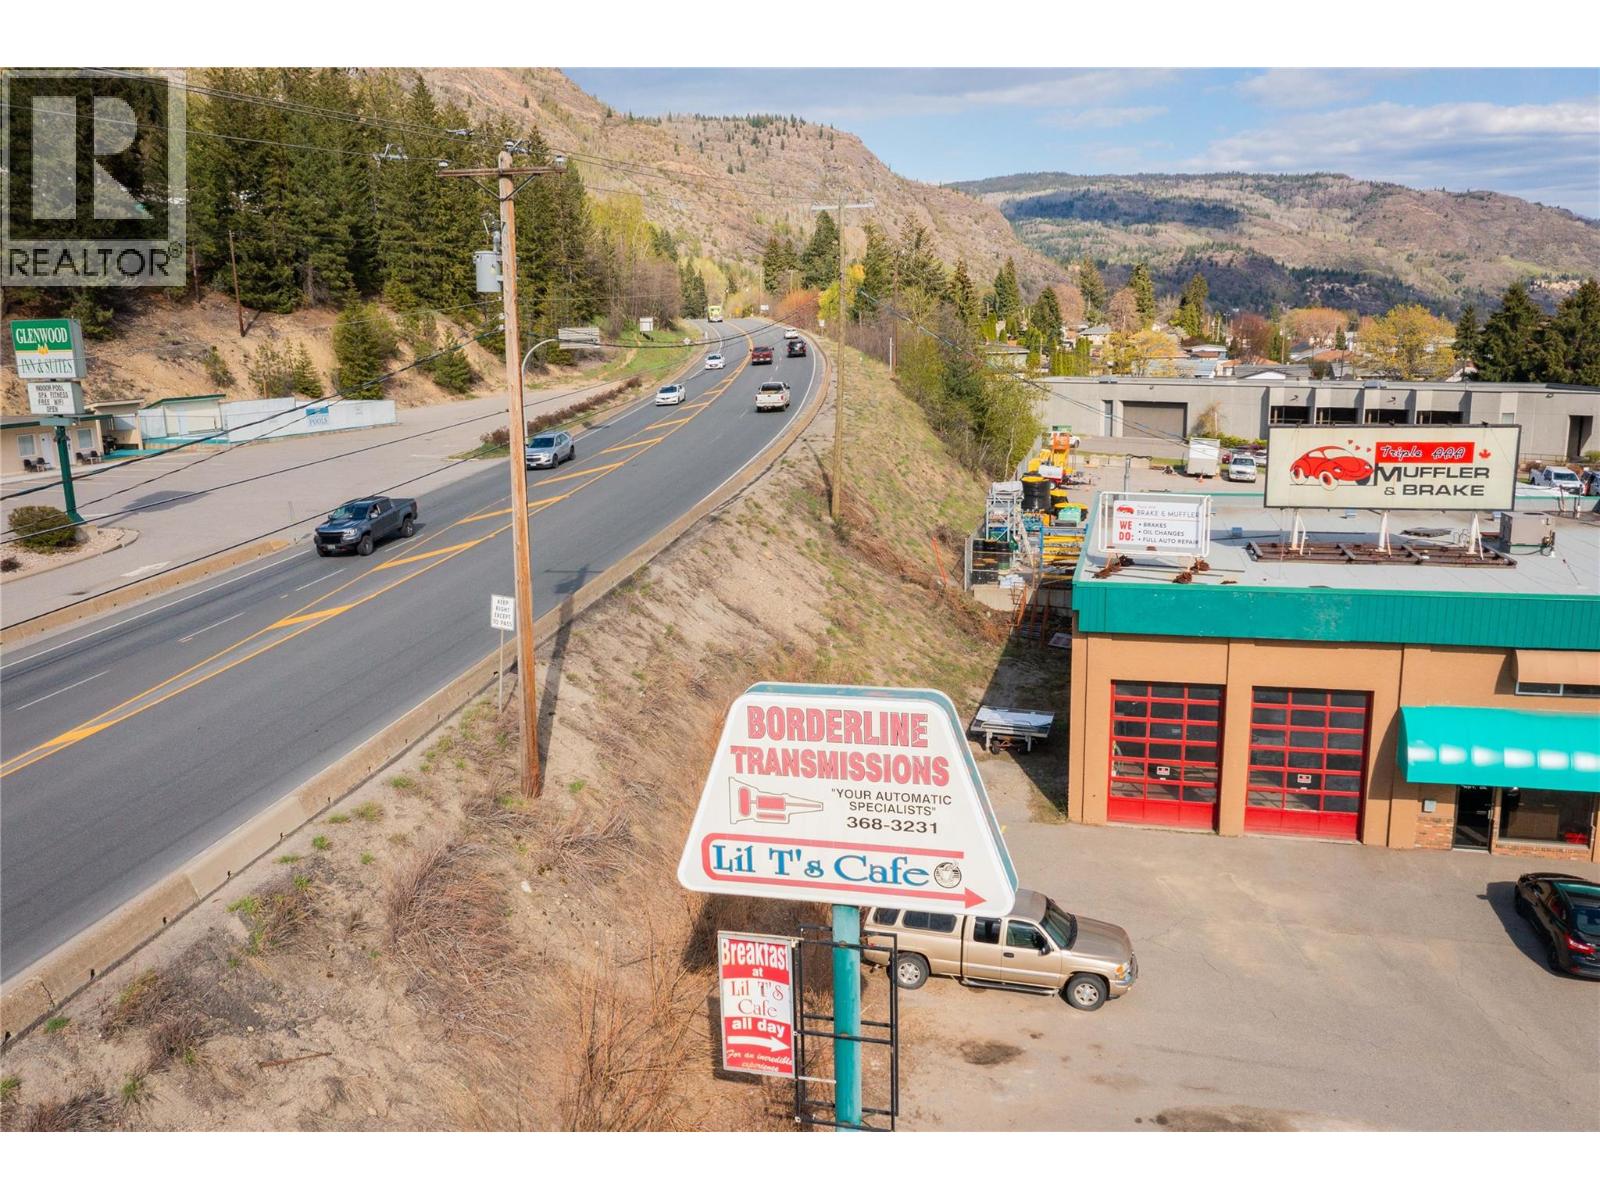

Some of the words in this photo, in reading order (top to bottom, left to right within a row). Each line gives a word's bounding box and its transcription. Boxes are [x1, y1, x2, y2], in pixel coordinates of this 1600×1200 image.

[16, 328, 68, 344] GLENWOOD
[21, 359, 36, 373] INN
[45, 358, 73, 373] SUITES
[1380, 445, 1422, 461] Triple
[1432, 447, 1465, 460] AAA
[1375, 464, 1490, 485] MUFFLER
[1384, 486, 1395, 496] &
[1402, 484, 1485, 497] BRAKE
[1137, 509, 1158, 517] BRAKE
[1119, 521, 1132, 530] WE
[1119, 532, 1134, 541] DO:
[747, 705, 929, 748] BORDERLINE
[730, 745, 950, 787] TRANSMISSIONS
[831, 788, 872, 801] "YOUR
[876, 790, 952, 806] AUTOMATIC
[849, 801, 936, 816] SPECIALISTS"
[846, 816, 938, 834] 368-3231
[712, 844, 756, 873] Lil
[769, 847, 824, 879] T's
[834, 854, 930, 887] Cafe
[752, 967, 763, 977] at
[731, 981, 749, 997] Lil
[738, 999, 778, 1018] Cafe
[732, 1017, 752, 1030] all
[757, 1018, 785, 1038] day
[726, 1049, 741, 1059] For
